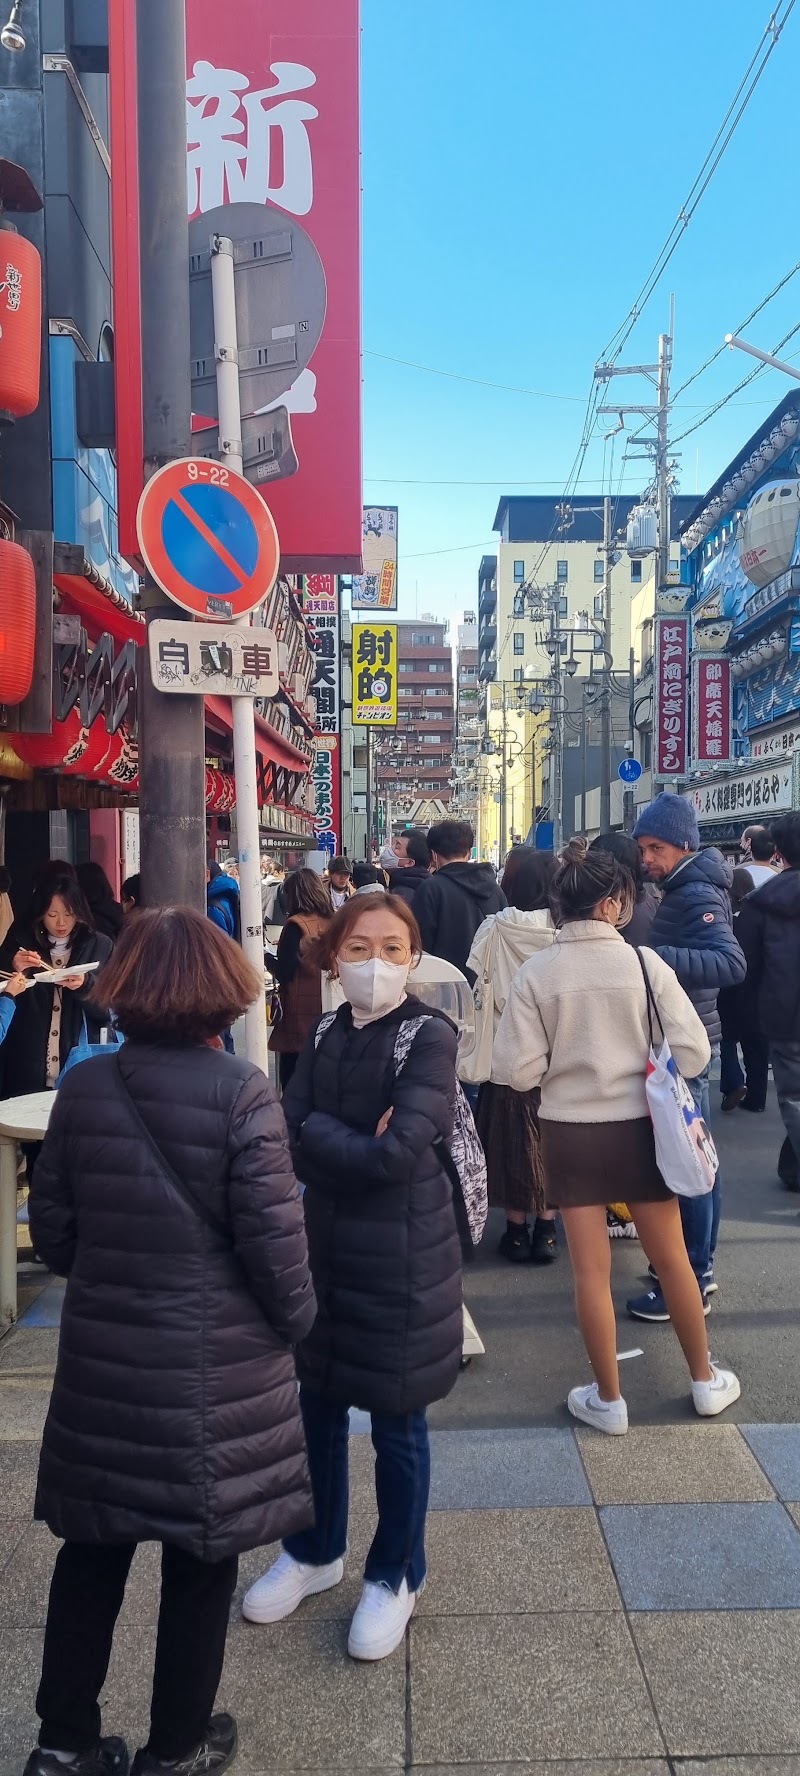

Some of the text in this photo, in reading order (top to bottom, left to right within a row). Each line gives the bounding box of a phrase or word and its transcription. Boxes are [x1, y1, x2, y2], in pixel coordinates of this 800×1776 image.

[186, 60, 319, 216] 新
[187, 463, 230, 487] 9-22
[305, 616, 337, 628] 大相撲
[356, 629, 393, 703] 射的
[356, 711, 392, 720] チャンピオン
[661, 626, 683, 770] 江戸前にぎりすし
